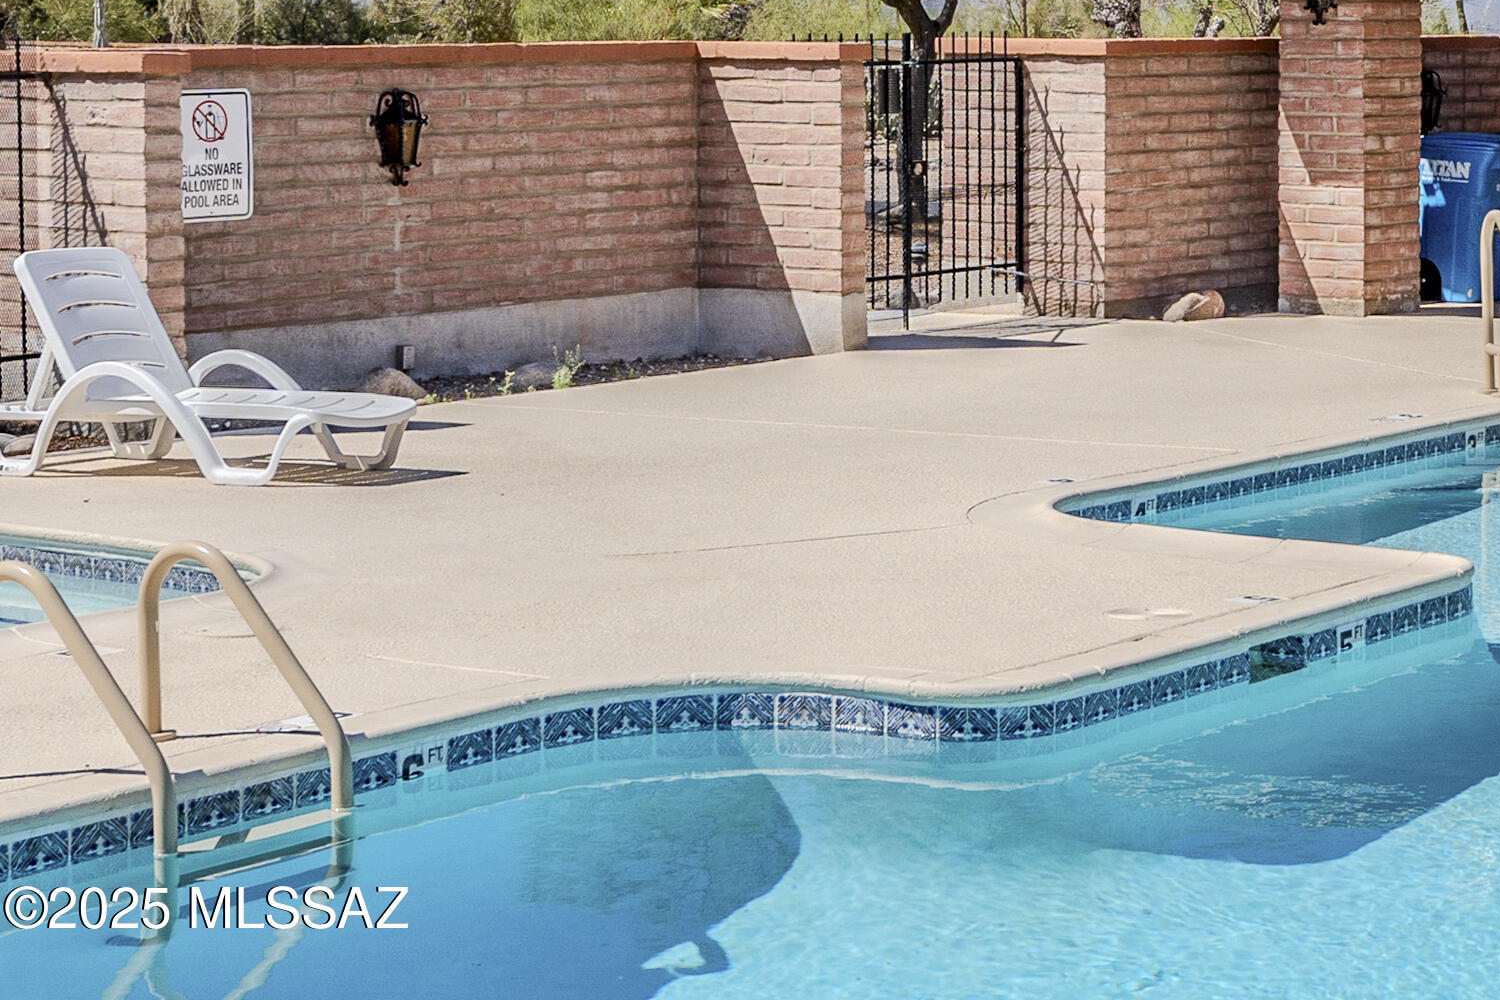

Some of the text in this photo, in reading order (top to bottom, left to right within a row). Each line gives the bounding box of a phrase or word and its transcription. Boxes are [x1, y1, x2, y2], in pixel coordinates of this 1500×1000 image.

[205, 147, 219, 160] NO
[182, 162, 242, 177] GLASSWARE
[182, 178, 242, 193] ALLOWED IN
[184, 194, 240, 208] POOL AREA
[1146, 499, 1155, 511] FT
[1340, 624, 1364, 652] 5 FT
